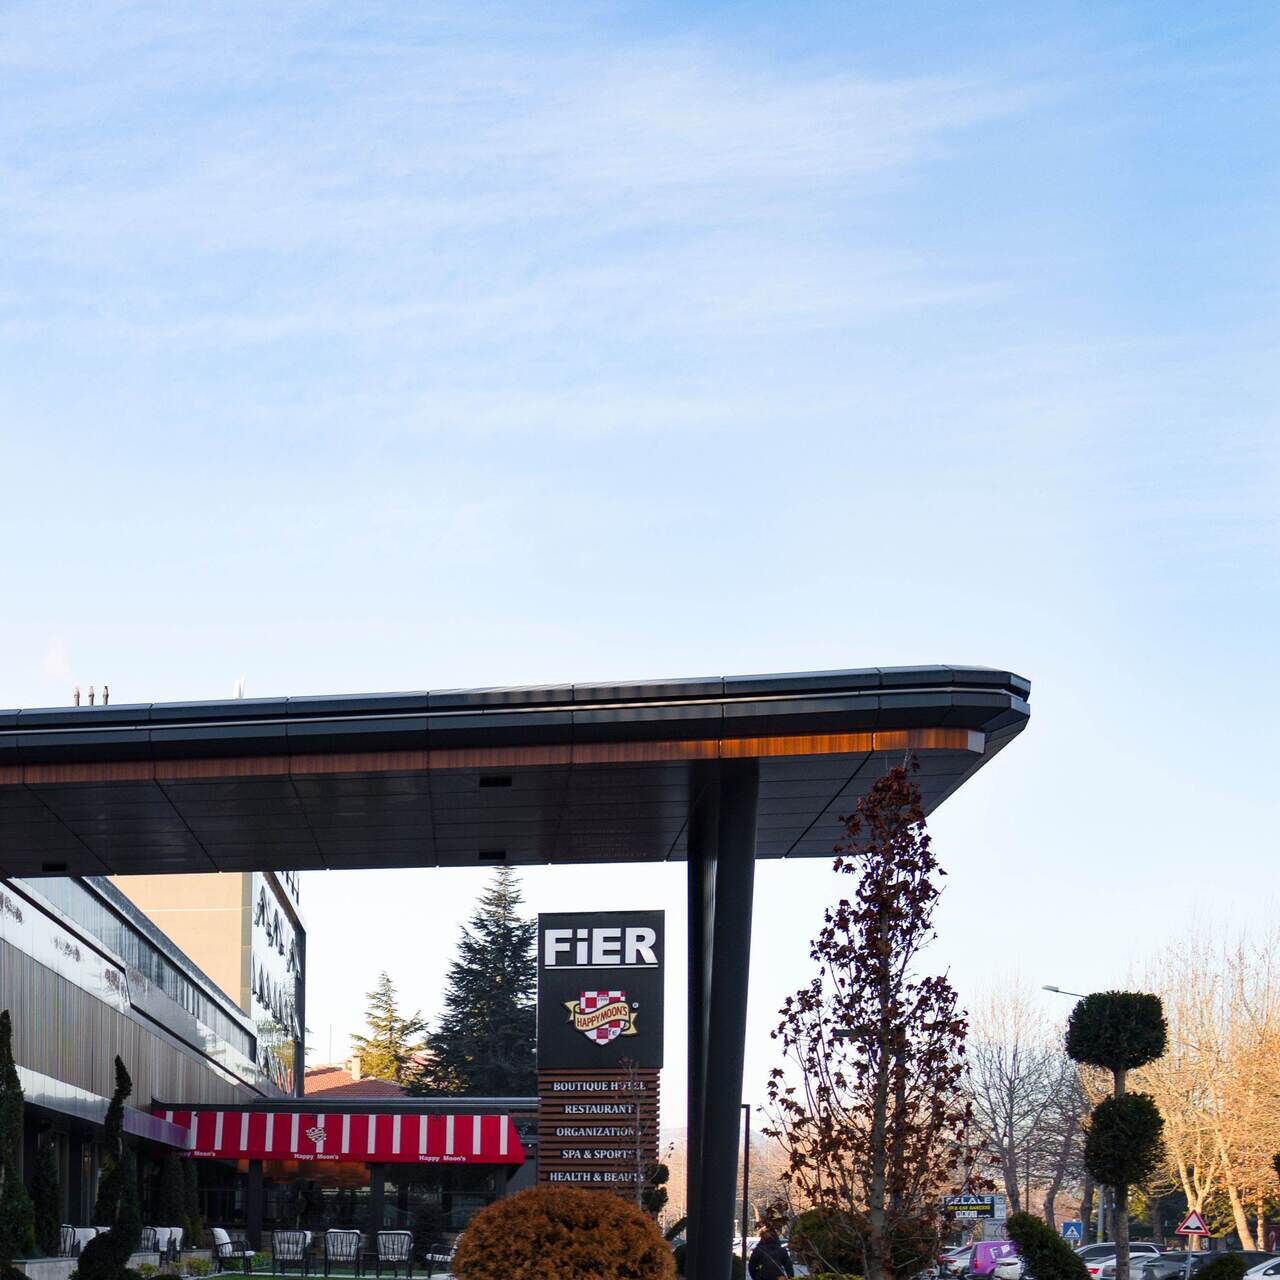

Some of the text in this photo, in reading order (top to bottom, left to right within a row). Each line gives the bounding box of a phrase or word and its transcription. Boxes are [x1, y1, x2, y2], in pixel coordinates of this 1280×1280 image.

[544, 927, 659, 966] FiER
[553, 1081, 609, 1091] BOUTIQUE
[564, 1104, 634, 1114] RESTAURANT
[562, 1149, 582, 1159] SPA
[583, 1149, 592, 1159] &
[550, 1172, 591, 1182] HEALTH
[592, 1172, 602, 1182] &
